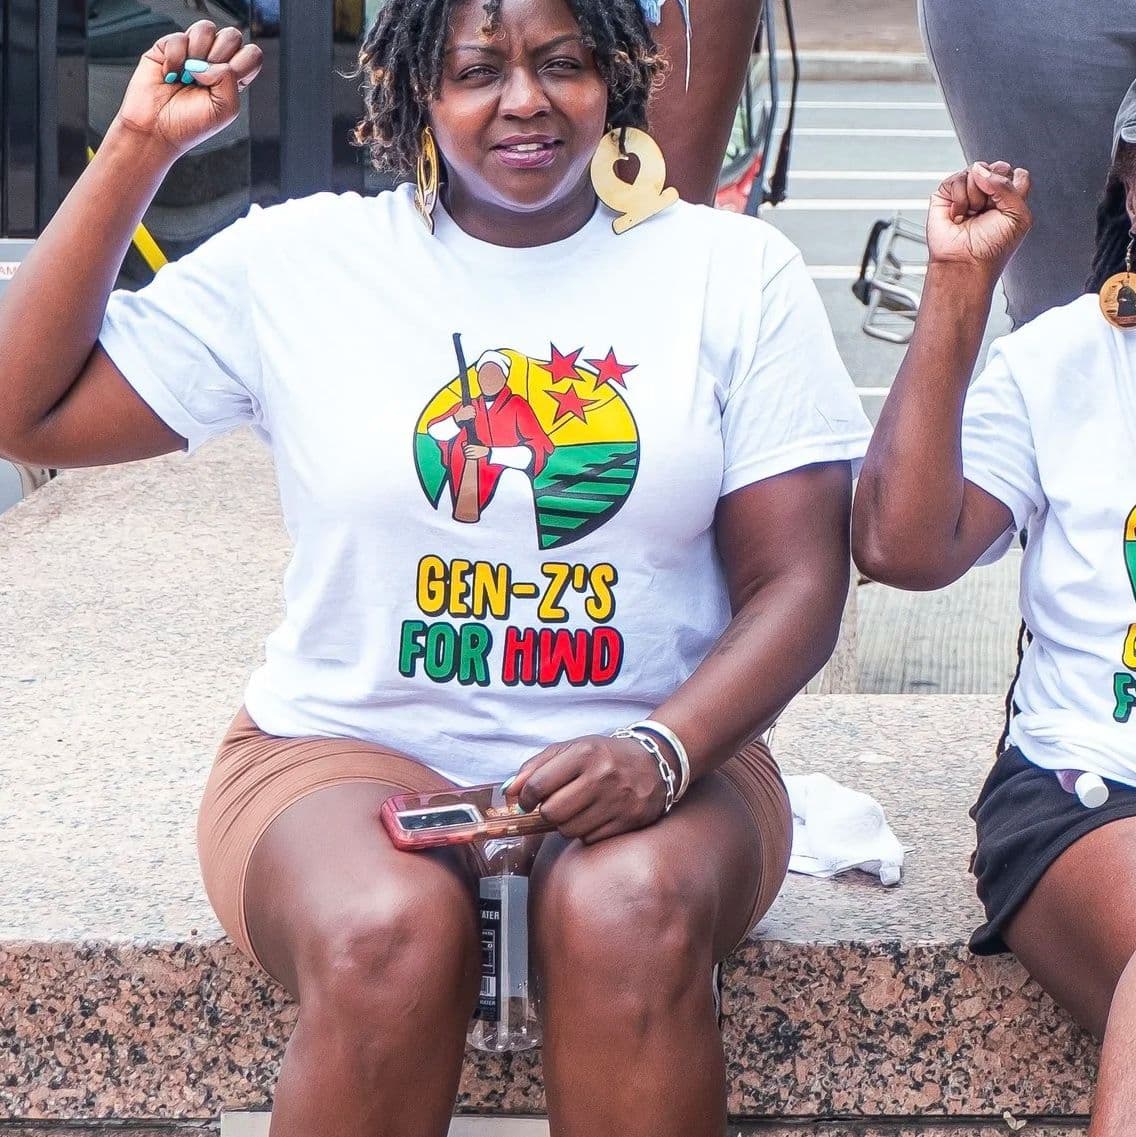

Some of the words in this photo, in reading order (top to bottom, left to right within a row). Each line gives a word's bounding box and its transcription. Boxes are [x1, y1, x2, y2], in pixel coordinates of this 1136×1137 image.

[416, 554, 618, 623] GEN-Z'S
[399, 620, 493, 687] FOR
[502, 626, 624, 688] HWD
